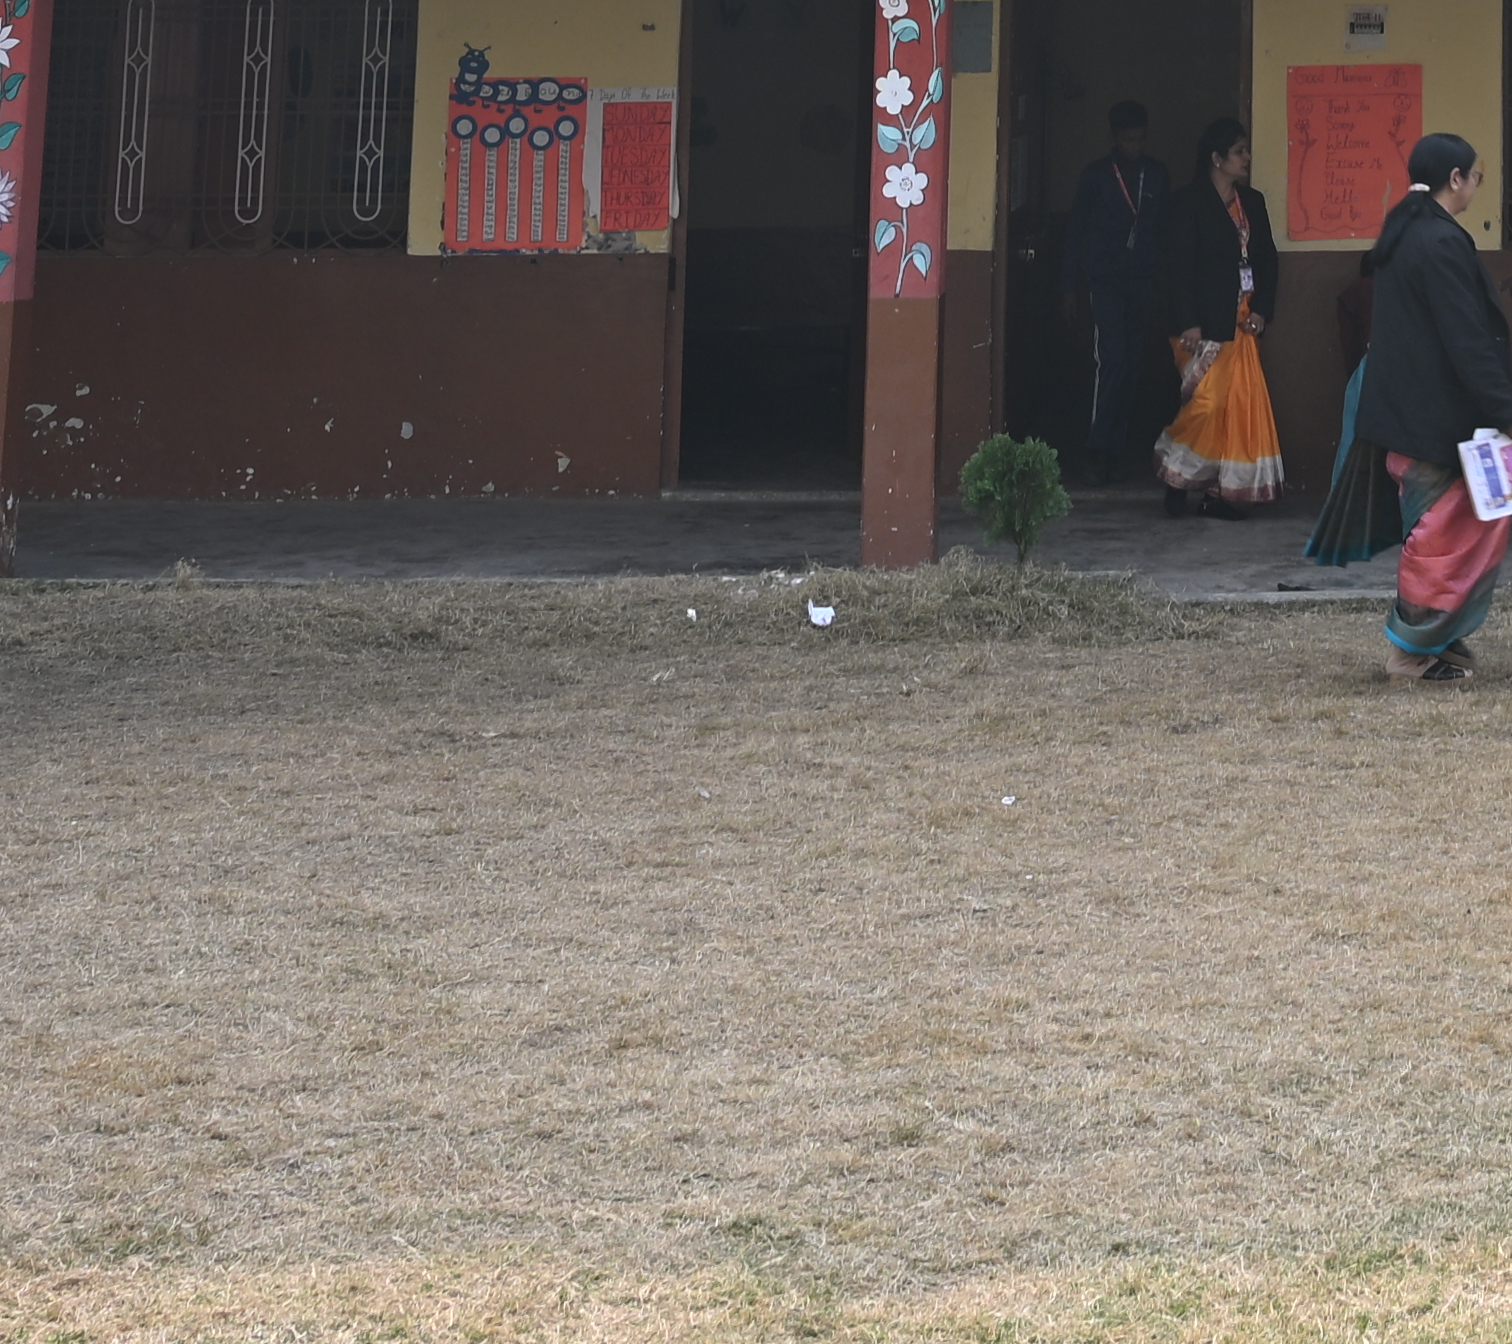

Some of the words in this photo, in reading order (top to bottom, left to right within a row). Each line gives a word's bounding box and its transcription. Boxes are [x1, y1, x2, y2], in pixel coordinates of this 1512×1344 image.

[605, 104, 670, 123] SUNDAY
[603, 125, 667, 145] MONDAY
[1326, 134, 1369, 150] Welcome
[603, 147, 667, 166] TUESDAY
[1325, 152, 1363, 169] Excuse
[603, 190, 666, 207] THURSDAY
[603, 211, 660, 228] FRIDAY
